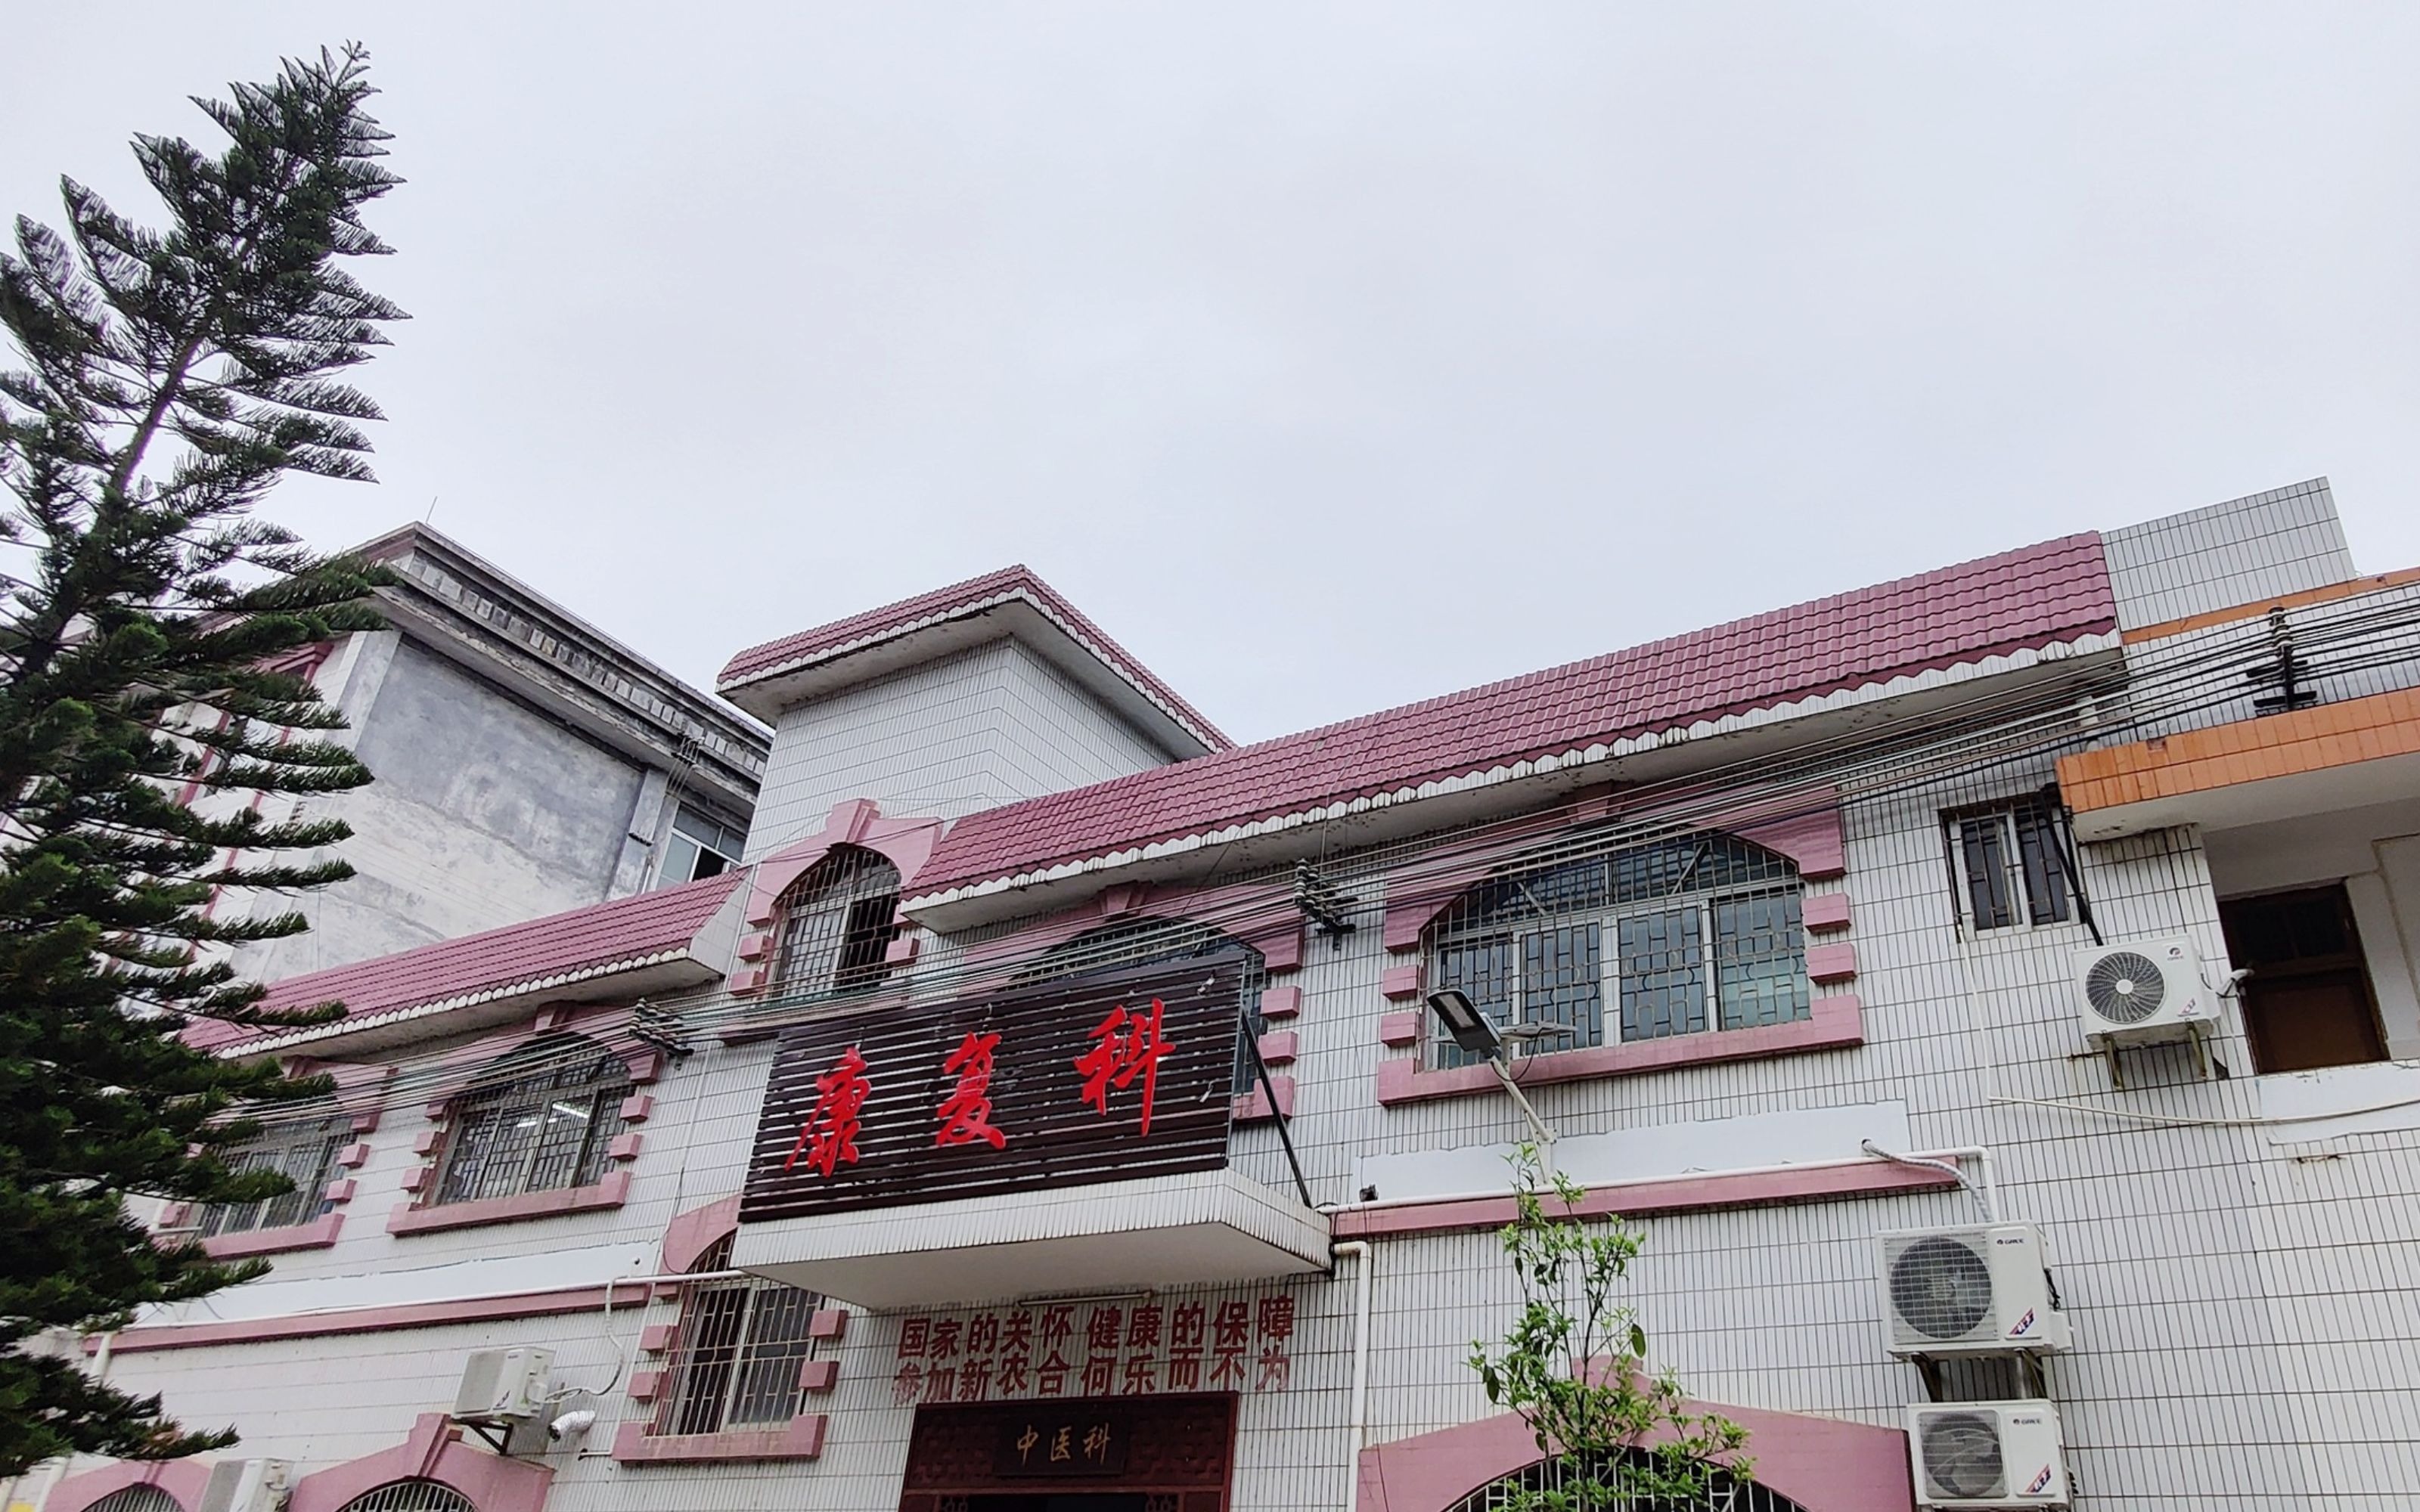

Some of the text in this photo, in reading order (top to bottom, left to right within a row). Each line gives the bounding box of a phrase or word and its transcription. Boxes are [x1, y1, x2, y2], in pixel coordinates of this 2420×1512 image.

[783, 997, 1174, 1177] 康复科
[1015, 1422, 1112, 1464] 中医科
